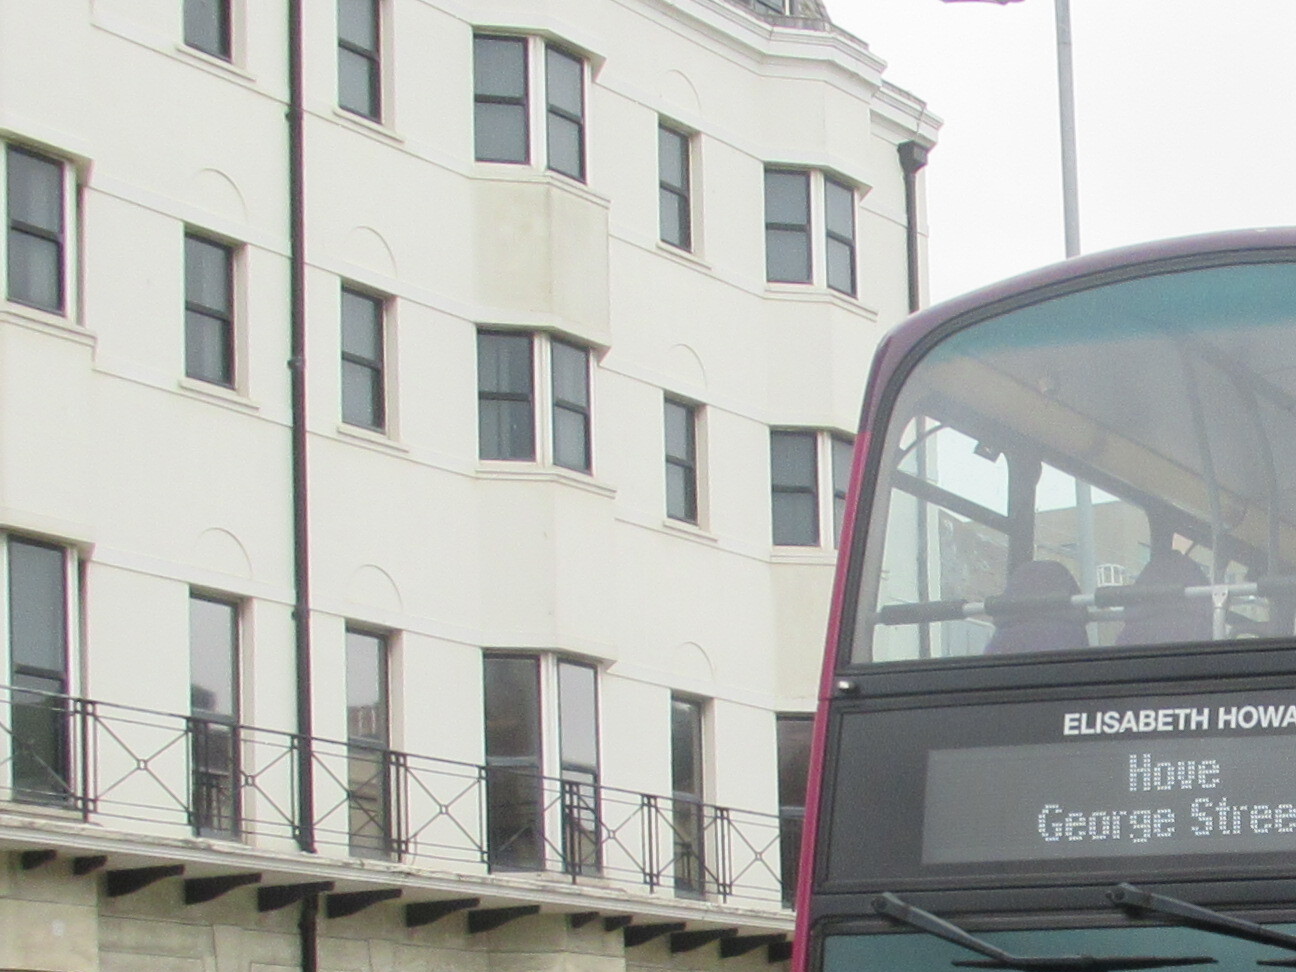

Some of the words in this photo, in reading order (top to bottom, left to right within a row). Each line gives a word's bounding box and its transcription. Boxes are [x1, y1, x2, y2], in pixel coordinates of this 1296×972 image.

[1062, 707, 1210, 736] ELISABETH
[1129, 753, 1220, 792] Hove
[1038, 804, 1176, 843] George
